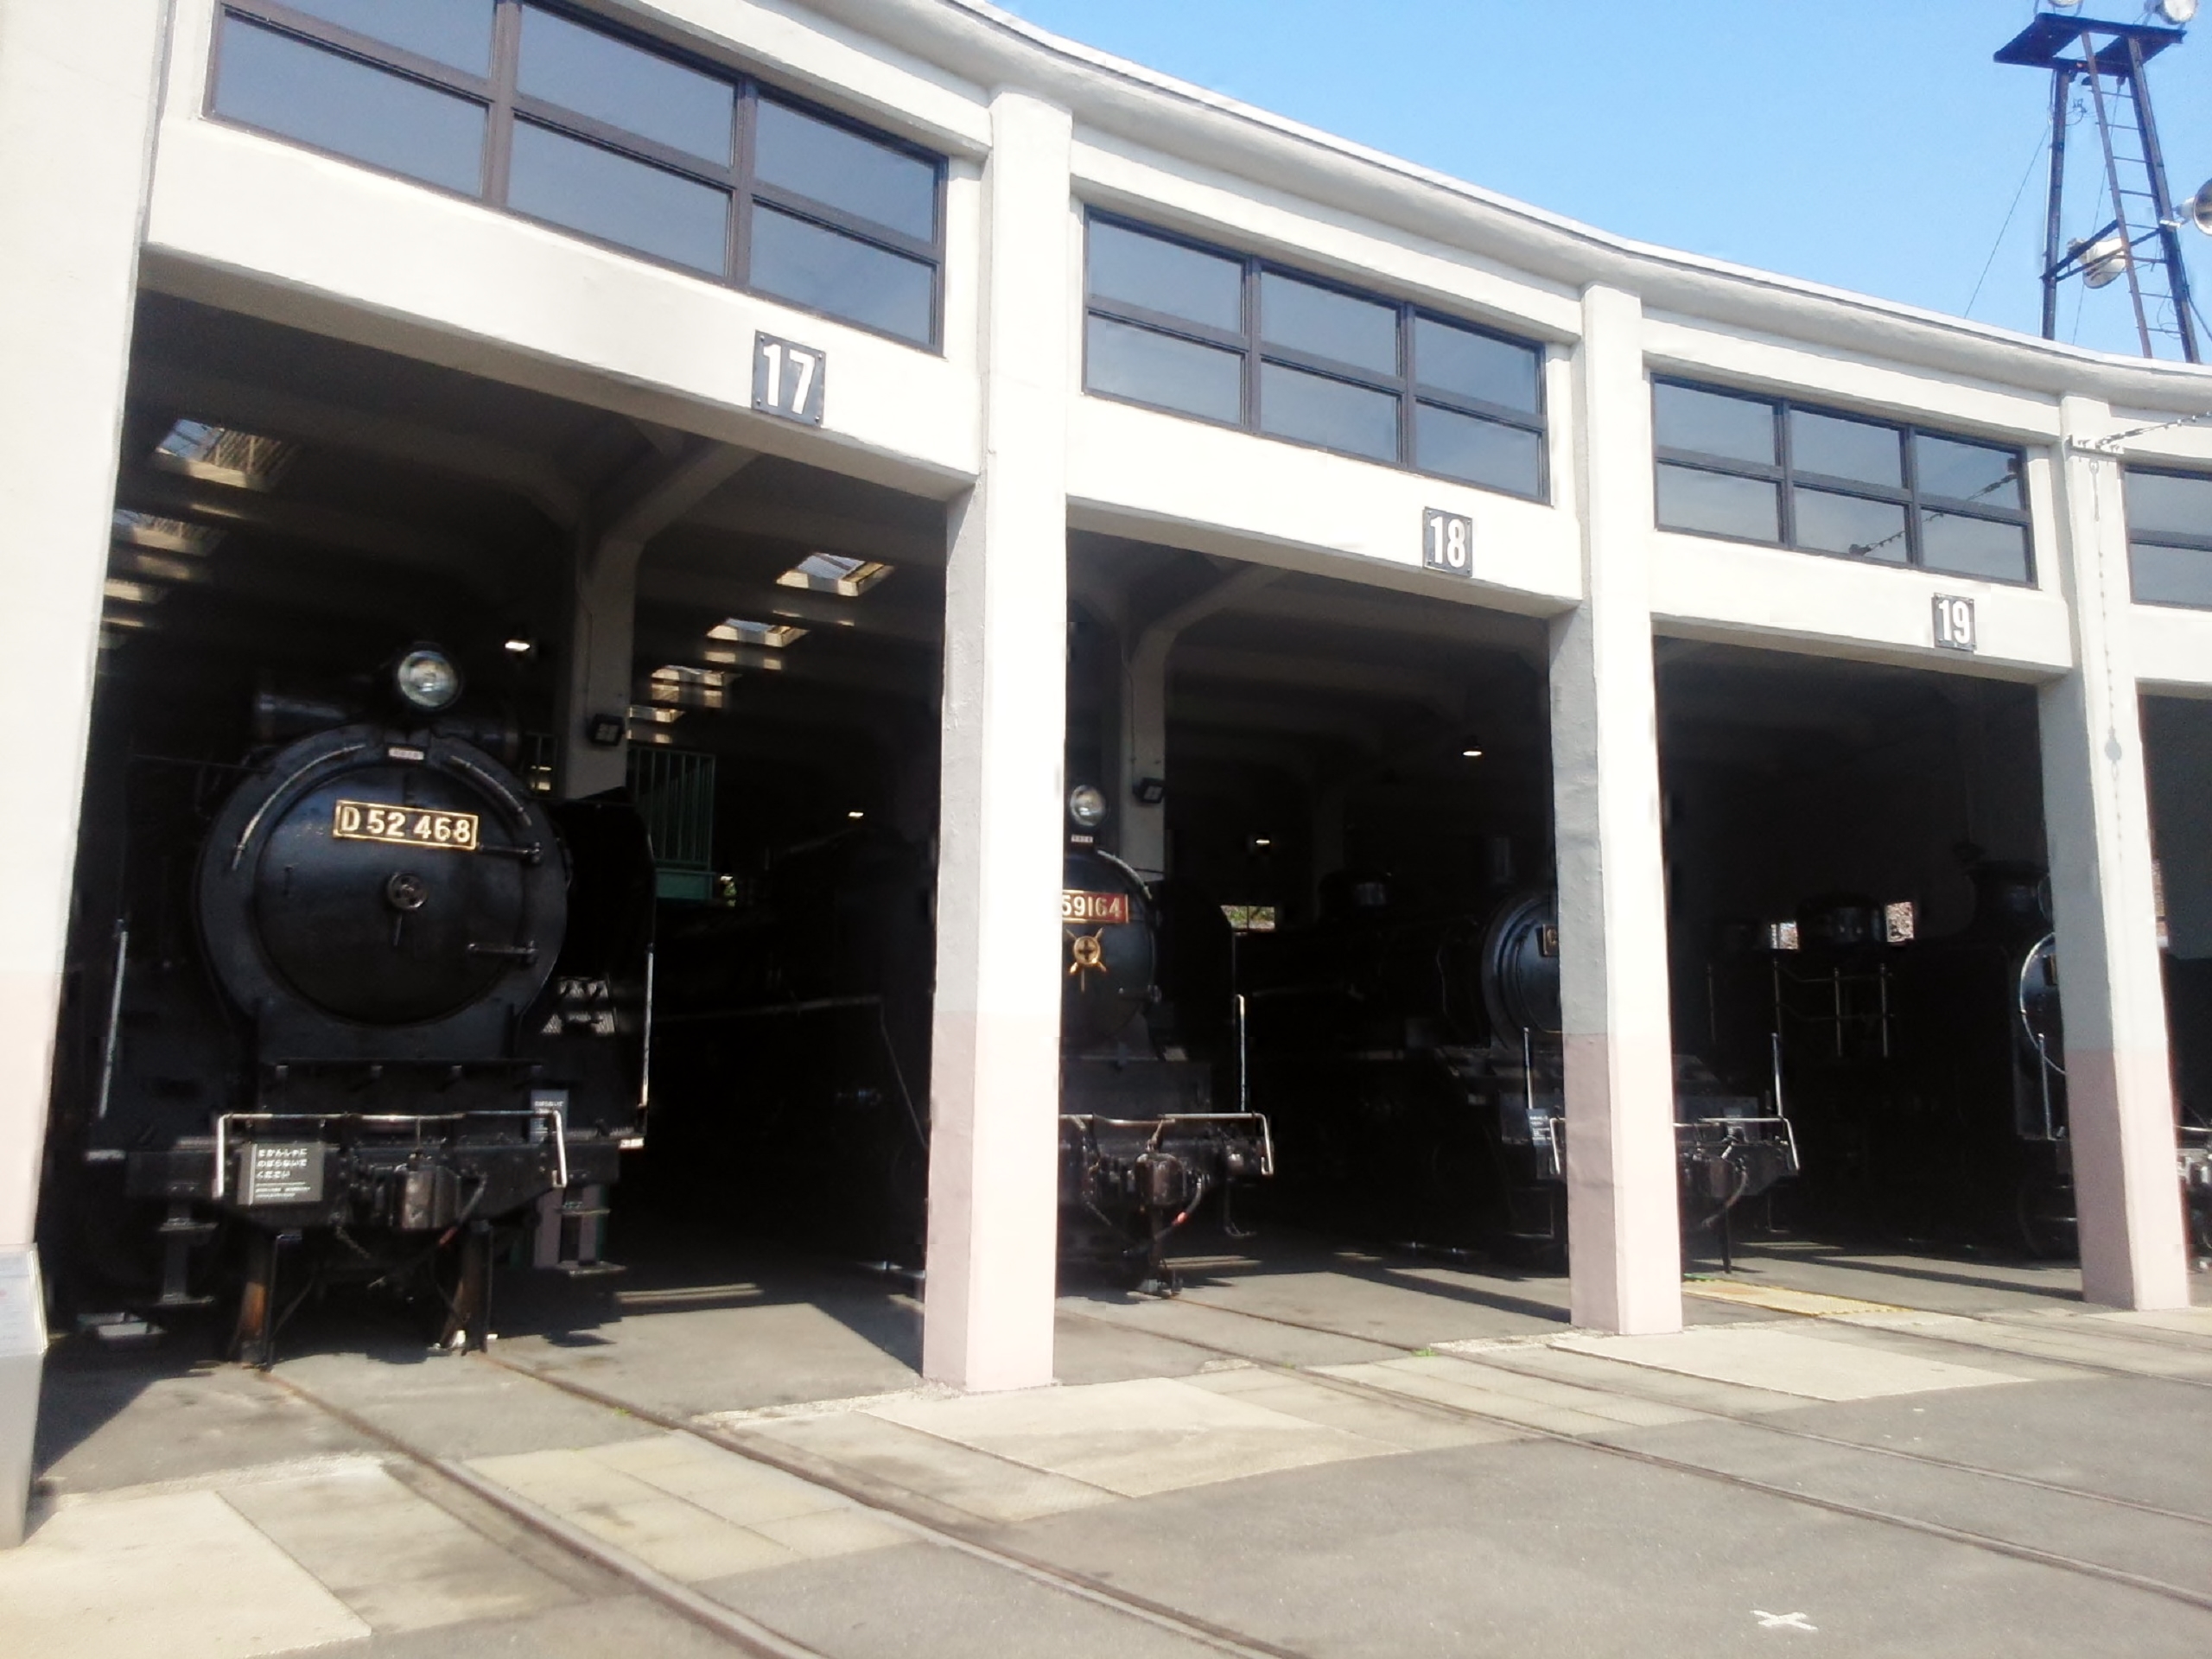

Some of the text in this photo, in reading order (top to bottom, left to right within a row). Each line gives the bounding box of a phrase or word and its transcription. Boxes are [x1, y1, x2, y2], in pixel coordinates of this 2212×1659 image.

[763, 344, 816, 415] 17
[1430, 516, 1465, 569] 18
[1938, 599, 1971, 645] 19
[413, 815, 471, 843] 468
